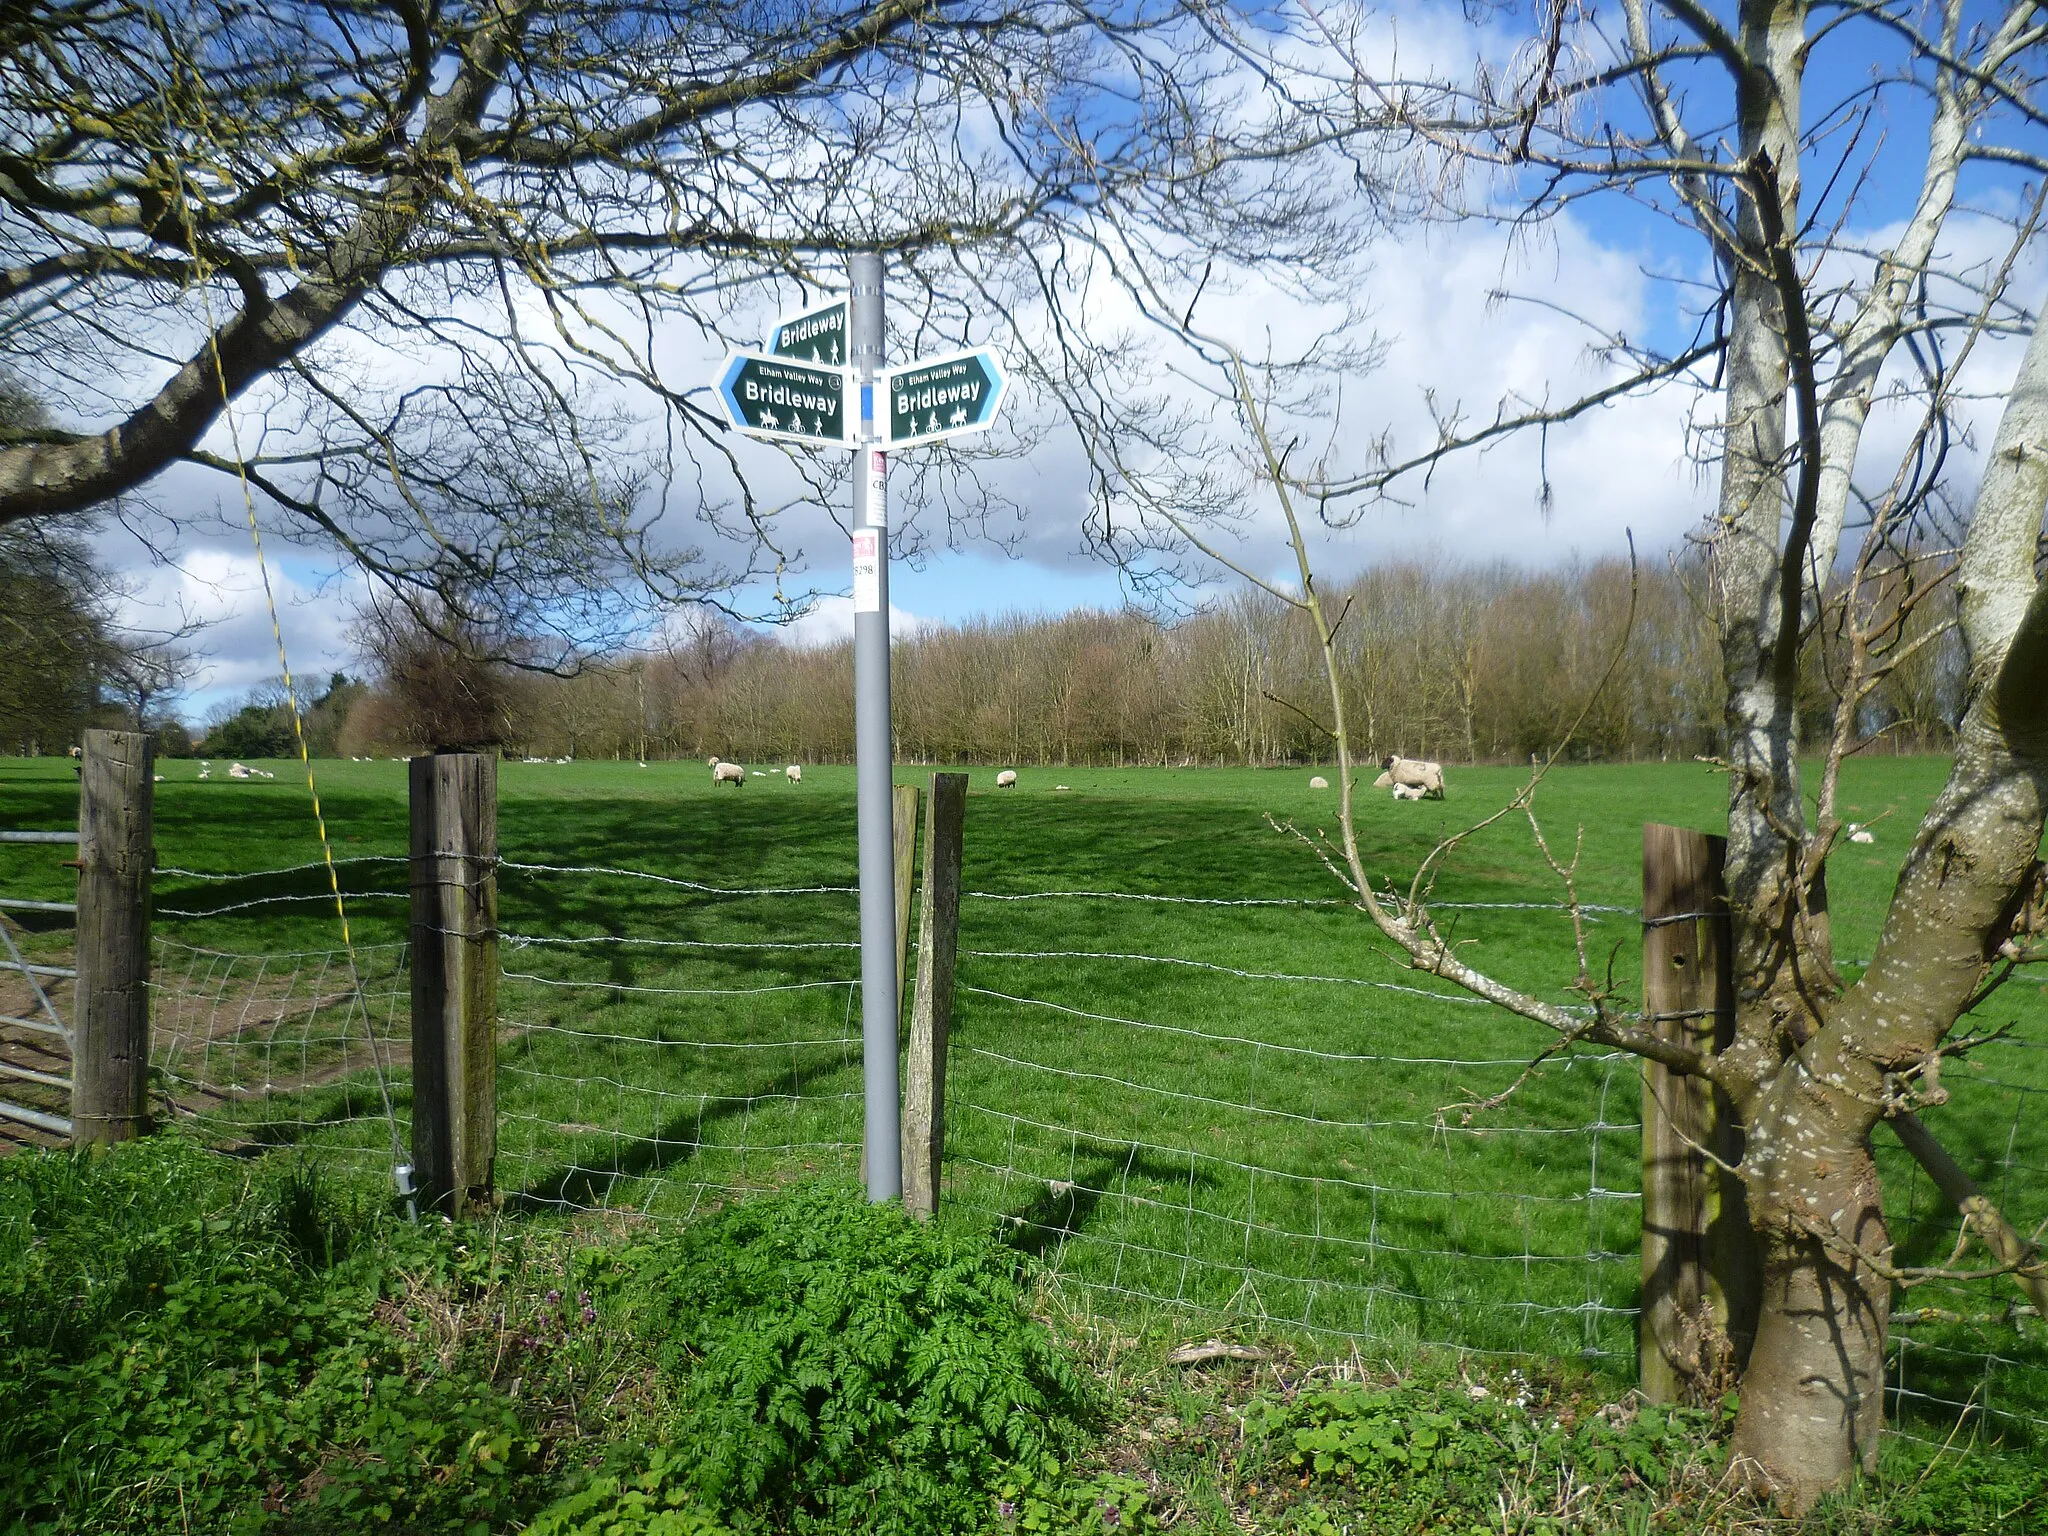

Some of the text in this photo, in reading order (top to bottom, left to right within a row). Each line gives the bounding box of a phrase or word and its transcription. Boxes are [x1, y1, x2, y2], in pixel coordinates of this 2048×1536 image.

[781, 312, 844, 348] Bridleway
[759, 366, 823, 387] Elham Valley Way
[909, 364, 966, 386] Elham Valley Way
[746, 381, 837, 416] Bridleway
[897, 381, 980, 415] Bridleway
